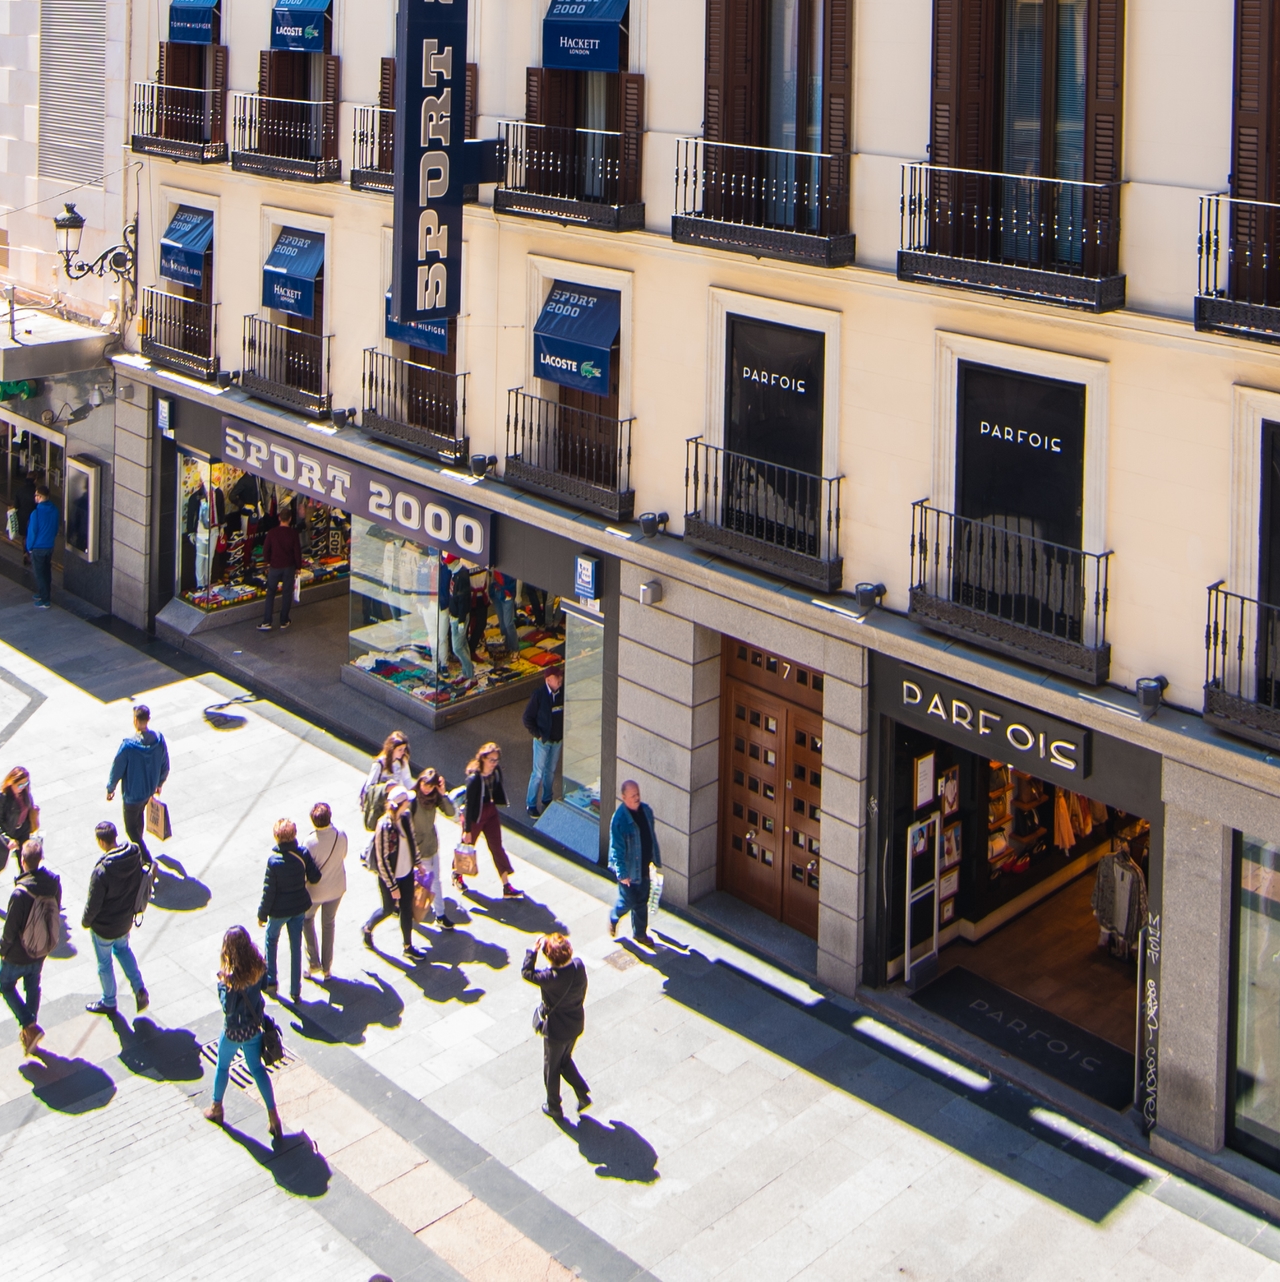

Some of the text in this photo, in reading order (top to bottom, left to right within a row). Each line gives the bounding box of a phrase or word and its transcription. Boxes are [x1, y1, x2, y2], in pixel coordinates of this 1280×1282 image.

[553, 4, 585, 14] 2000
[191, 22, 211, 30] HILFIGER
[276, 26, 303, 37] LACOSTE
[416, 38, 453, 311] SPORT
[170, 220, 192, 232] 2000
[175, 211, 204, 224] SPORT
[279, 234, 311, 249] SPORT
[274, 244, 298, 257] 2000
[552, 289, 598, 308] SPORT
[546, 301, 580, 318] 2000
[417, 324, 446, 336] HILFIGER
[540, 353, 578, 372] LACOSTE
[742, 365, 806, 394] PARFOIS
[980, 420, 1062, 453] PARFOIS
[225, 426, 485, 555] SPORT 2000
[331, 531, 340, 554] 405
[783, 663, 791, 679] 7
[902, 680, 1077, 771] PARFOIS
[969, 999, 1102, 1071] PARFOIS
